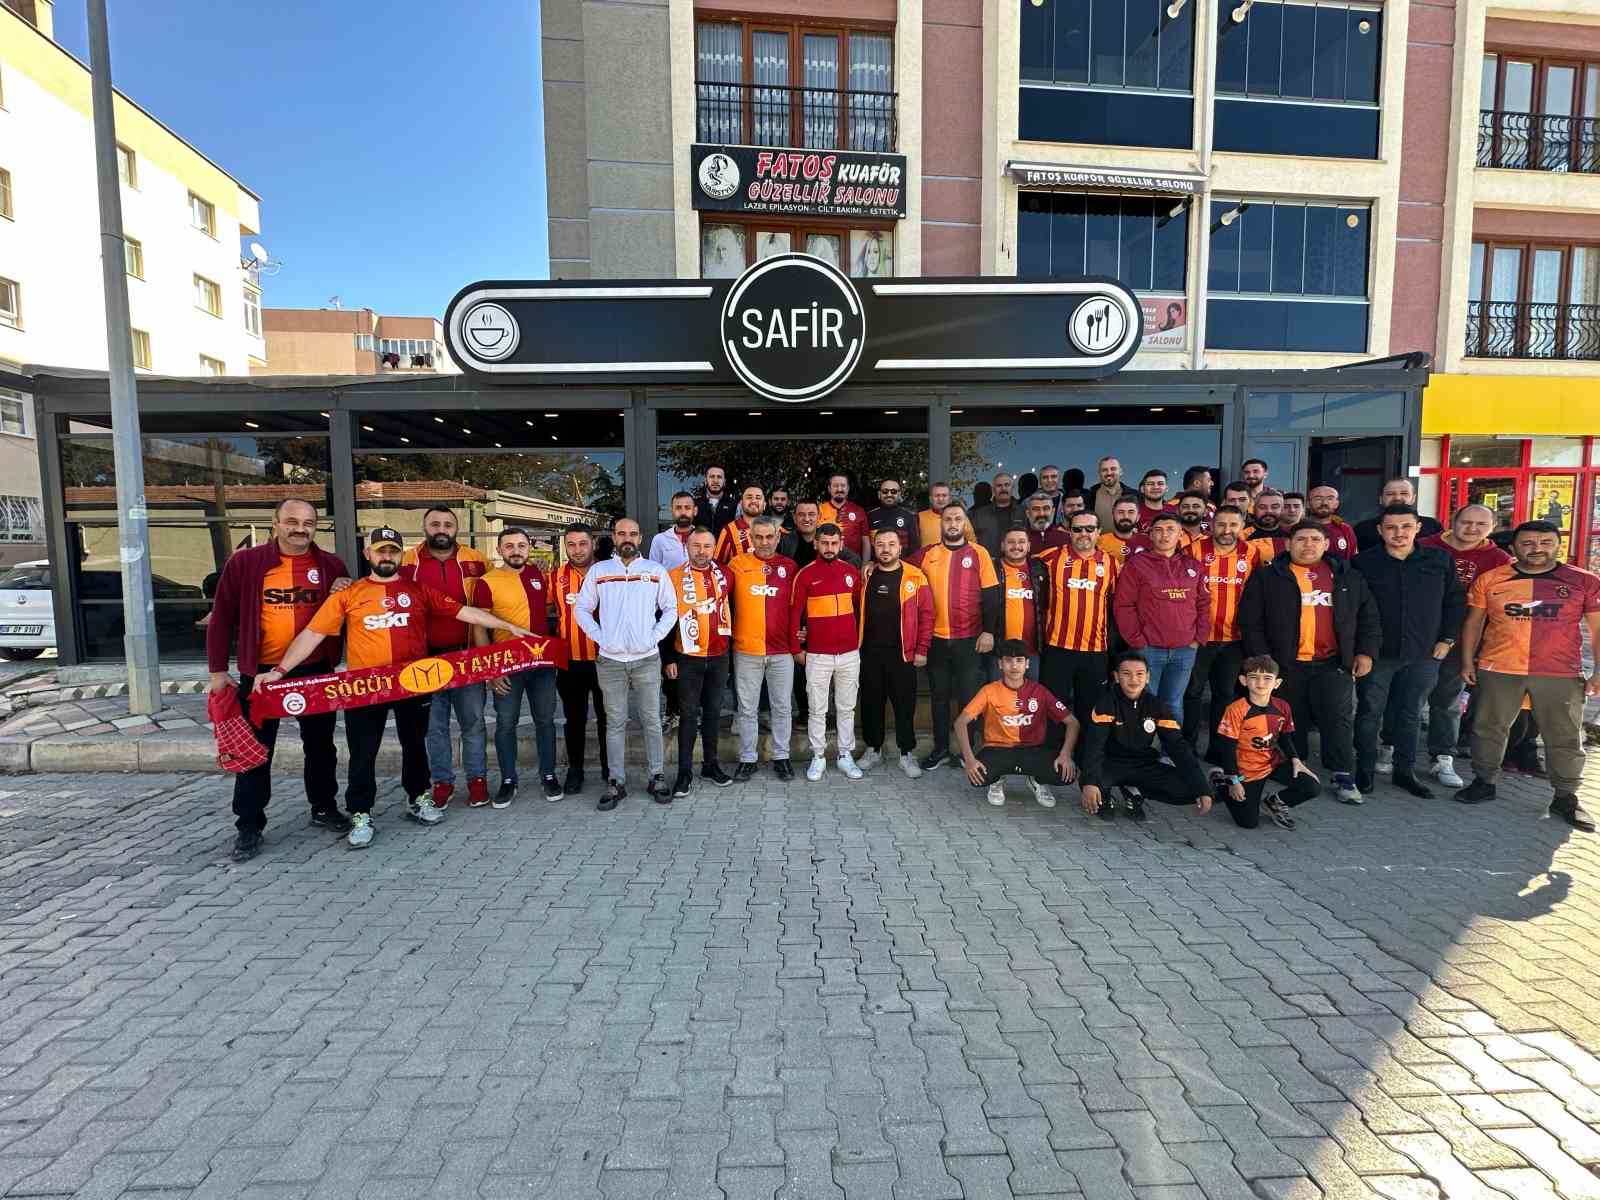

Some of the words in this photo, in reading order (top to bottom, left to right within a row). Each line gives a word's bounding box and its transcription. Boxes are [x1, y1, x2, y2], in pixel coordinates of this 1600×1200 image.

[838, 162, 901, 185] KUAFÖR
[743, 202, 767, 210] LAZER
[834, 186, 900, 206] SALONU
[742, 301, 844, 348] SAFİR
